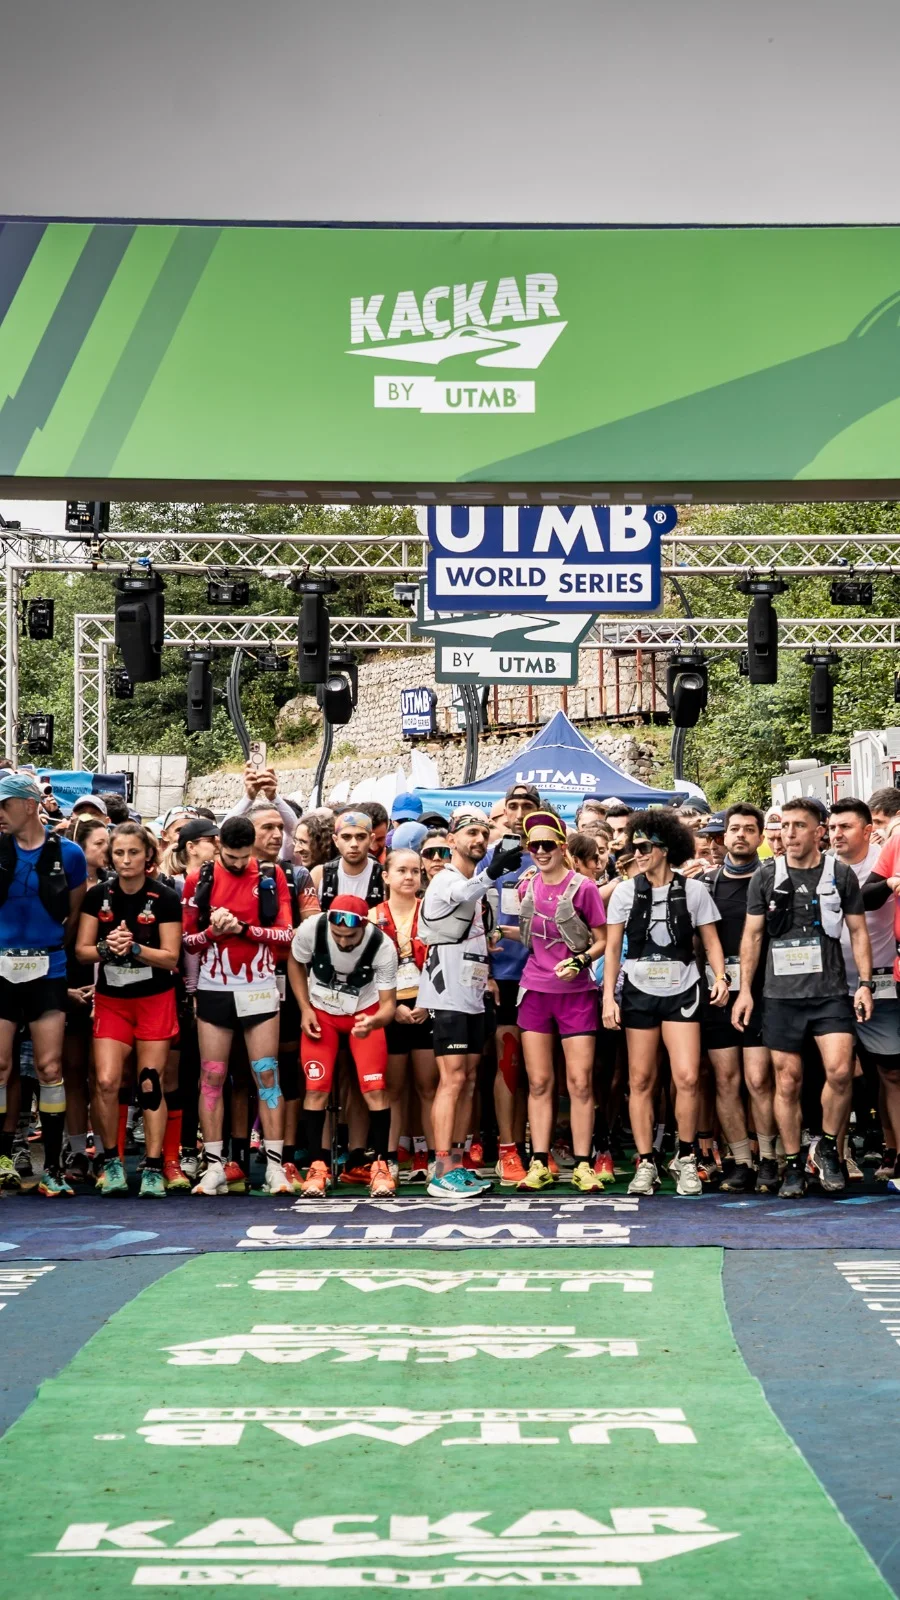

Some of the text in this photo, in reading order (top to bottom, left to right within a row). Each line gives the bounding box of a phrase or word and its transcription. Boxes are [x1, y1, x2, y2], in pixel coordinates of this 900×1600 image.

[350, 272, 560, 344] KAÇKAR
[388, 383, 517, 407] BY UTMB
[446, 567, 643, 593] WORLD SERIES
[453, 653, 557, 673] BY UTMB
[401, 690, 430, 714] UTMB
[515, 769, 597, 786] UTMB
[12, 962, 37, 971] 2749
[248, 992, 271, 1002] 2744
[246, 1223, 631, 1240] UTMB
[247, 1277, 653, 1294] UTMB
[167, 1410, 653, 1421] WORLD SERIES
[136, 1421, 698, 1447] UTMB
[55, 1506, 720, 1550] KACKAR
[181, 1569, 582, 1585] BY UTMB
